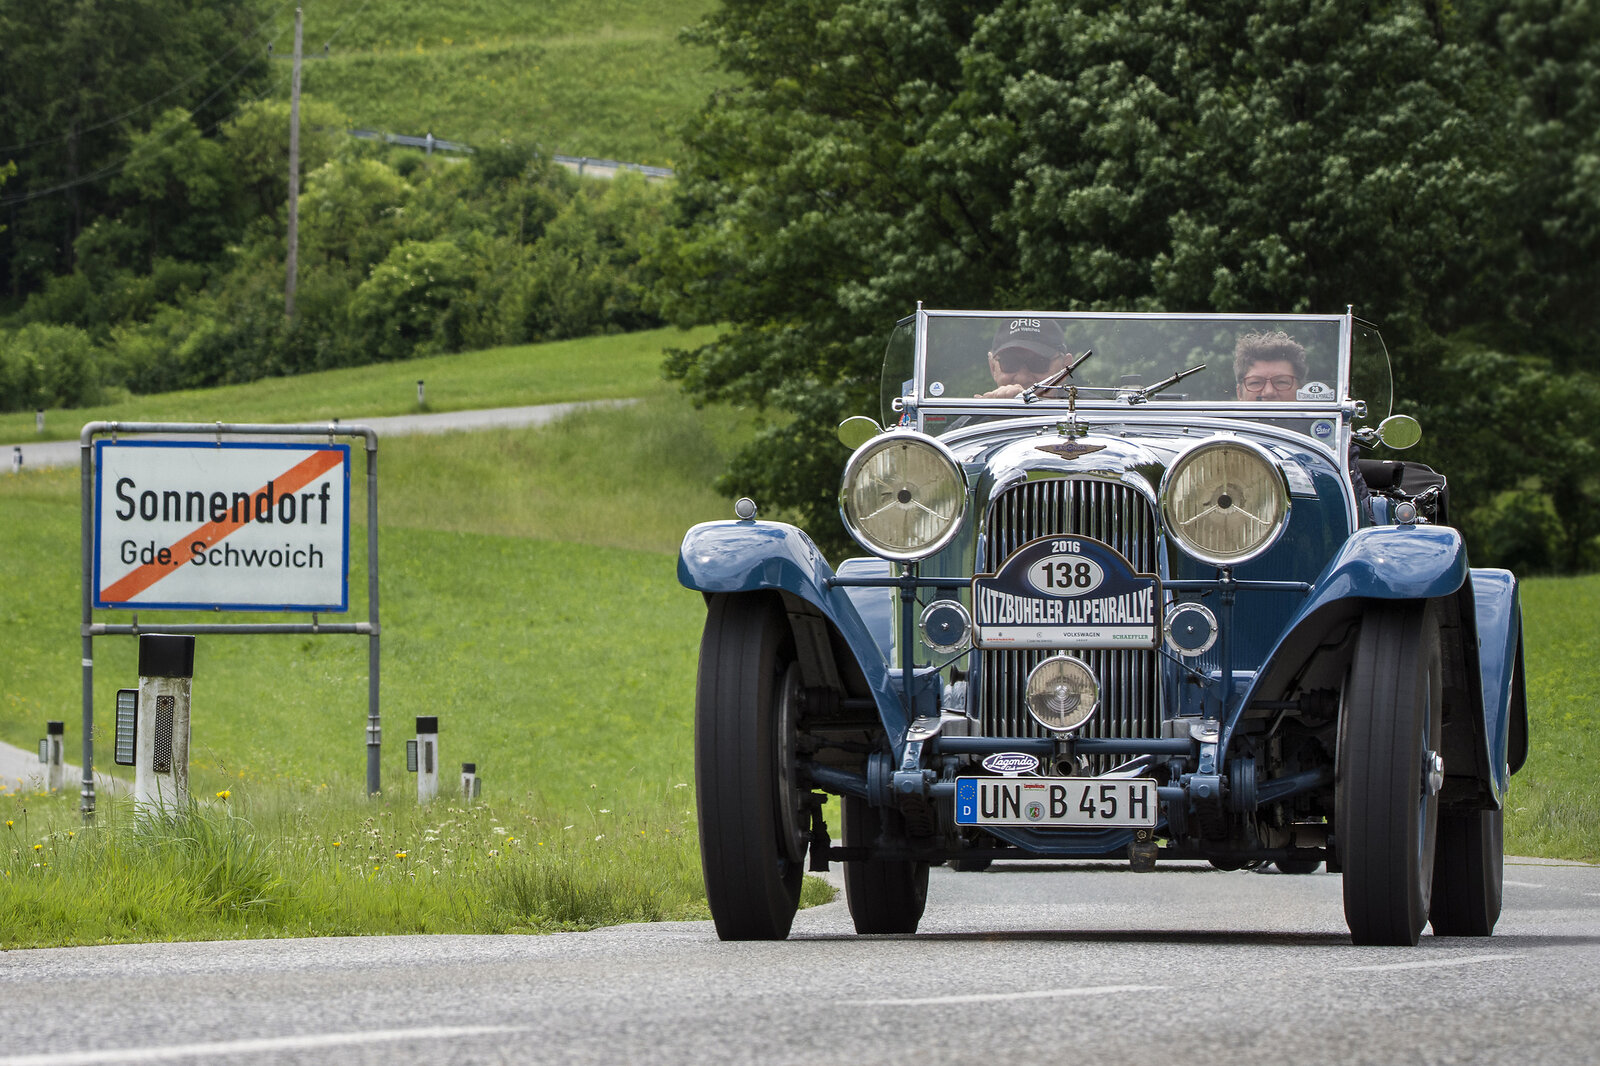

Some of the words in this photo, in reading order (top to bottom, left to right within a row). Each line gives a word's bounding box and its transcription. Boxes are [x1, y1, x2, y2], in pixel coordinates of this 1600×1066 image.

[1010, 318, 1041, 330] ORIS
[115, 477, 331, 525] Sonnendorf
[120, 539, 179, 566] Gde.
[190, 540, 324, 568] Schwoich
[1051, 540, 1081, 554] 2016
[1041, 562, 1092, 588] 138
[1066, 585, 1155, 624] ALPENRALLYE
[988, 754, 1034, 770] Lagonda
[963, 806, 972, 816] D
[980, 784, 1021, 819] UN
[1050, 784, 1068, 819] B
[1079, 784, 1118, 819] 45
[1128, 784, 1148, 819] H
